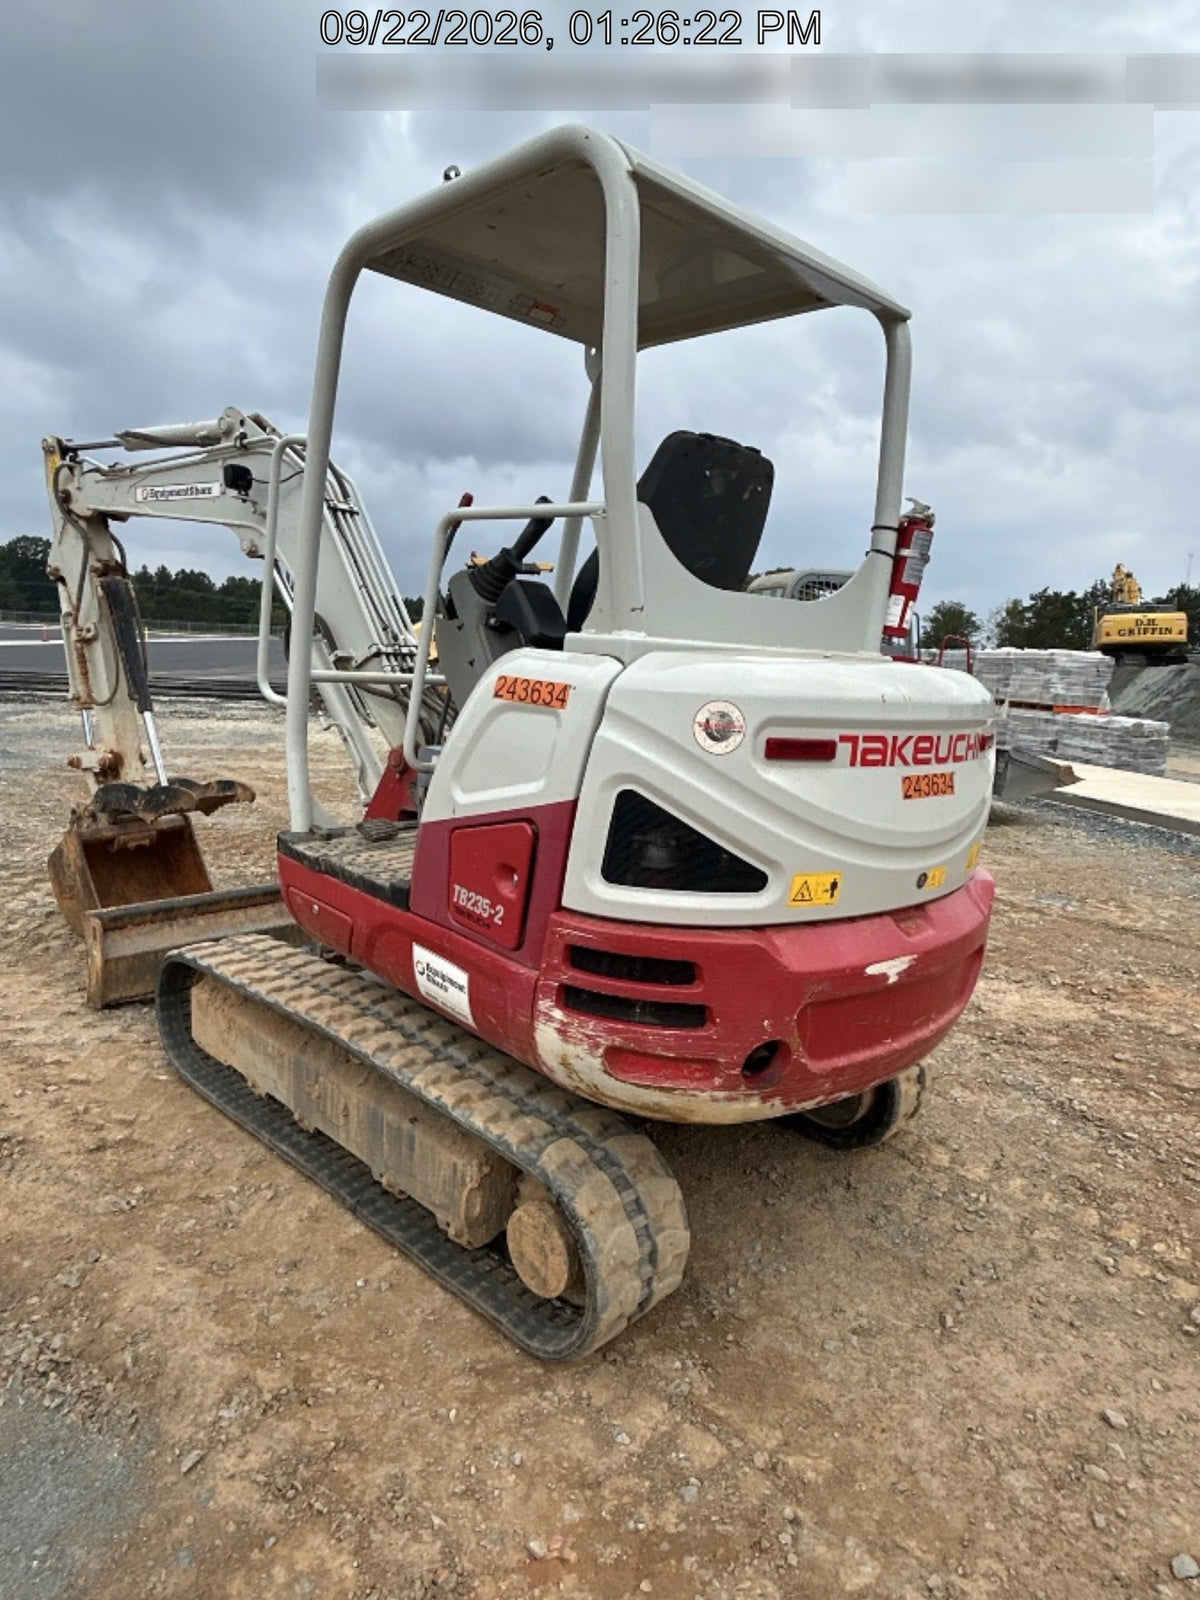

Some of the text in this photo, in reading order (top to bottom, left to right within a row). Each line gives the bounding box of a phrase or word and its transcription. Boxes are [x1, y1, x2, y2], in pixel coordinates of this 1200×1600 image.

[1118, 627, 1172, 637] GRIFFIN
[494, 675, 568, 708] 243634
[838, 733, 980, 767] TAKEUCHI
[902, 772, 955, 799] 243634
[453, 883, 504, 925] TB235-2
